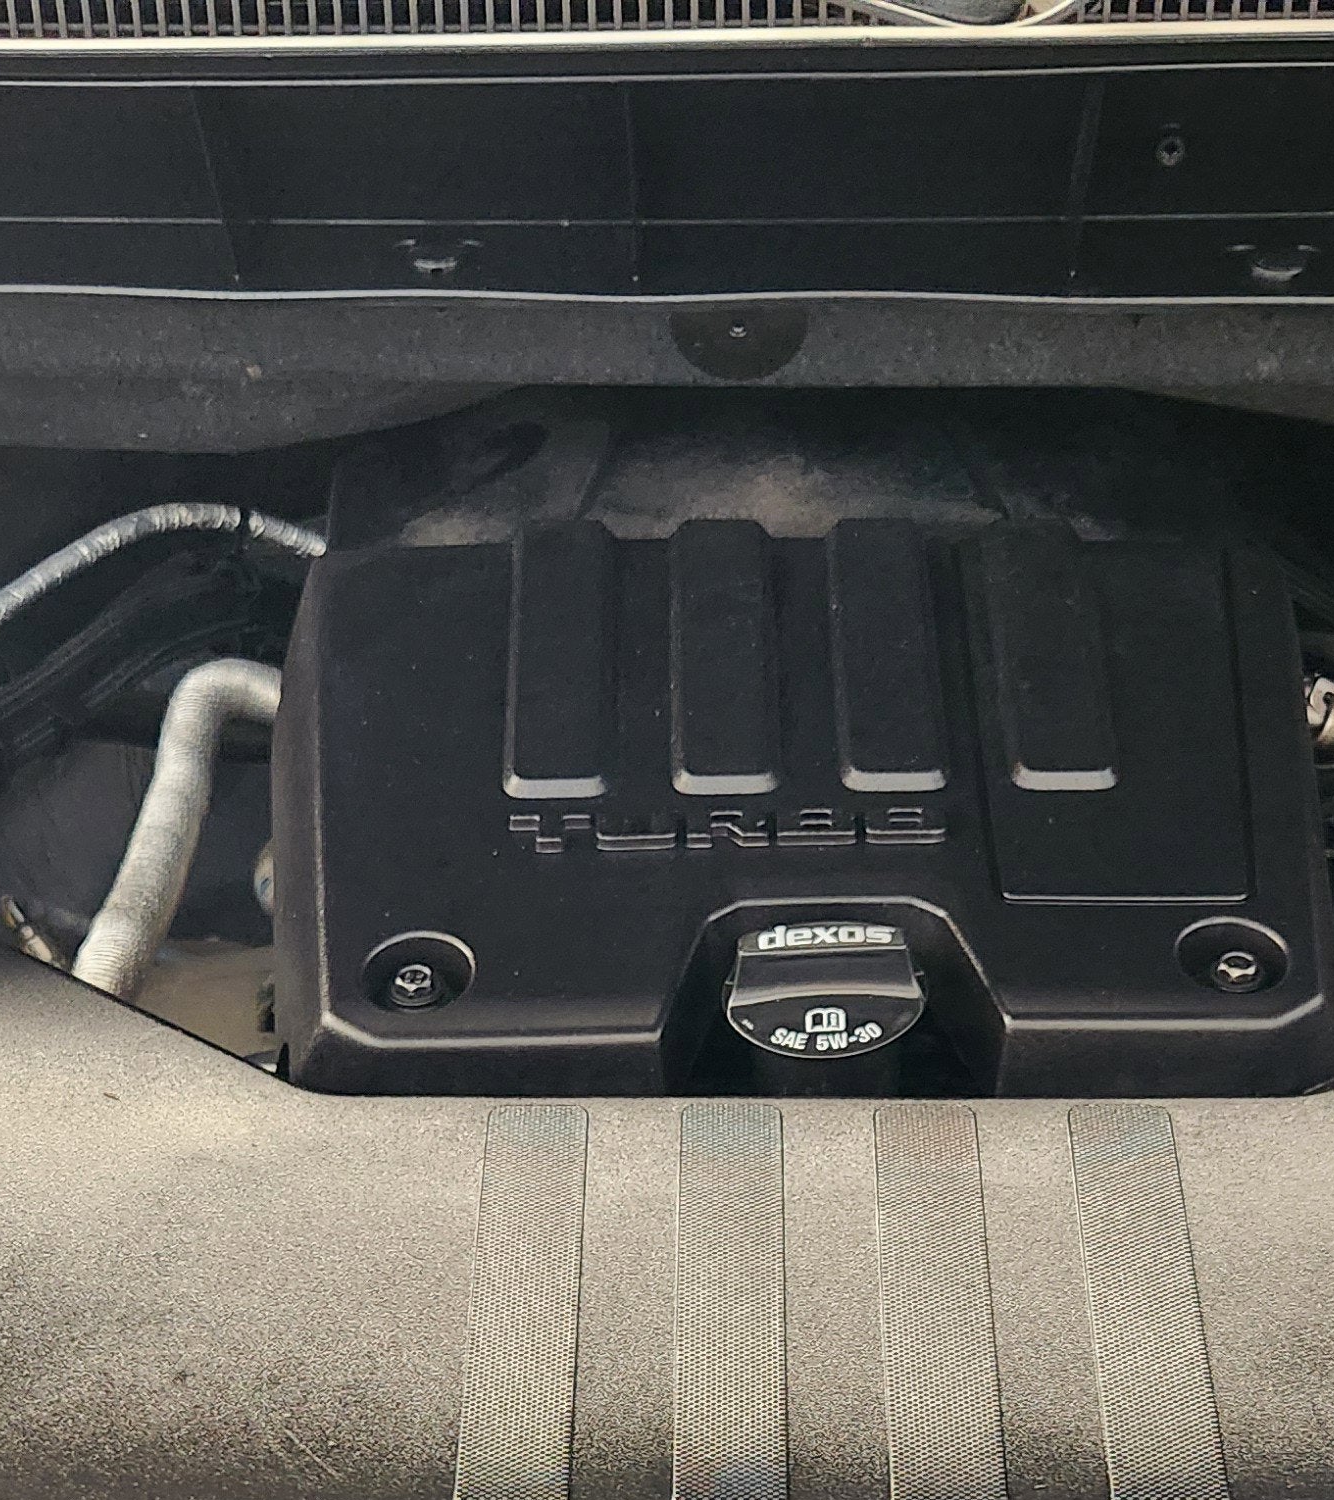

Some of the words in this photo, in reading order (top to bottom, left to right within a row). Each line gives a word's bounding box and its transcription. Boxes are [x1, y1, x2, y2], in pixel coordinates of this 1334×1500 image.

[758, 925, 896, 950] dexos
[770, 1027, 809, 1050] SAE
[816, 1022, 883, 1051] 5W-30
